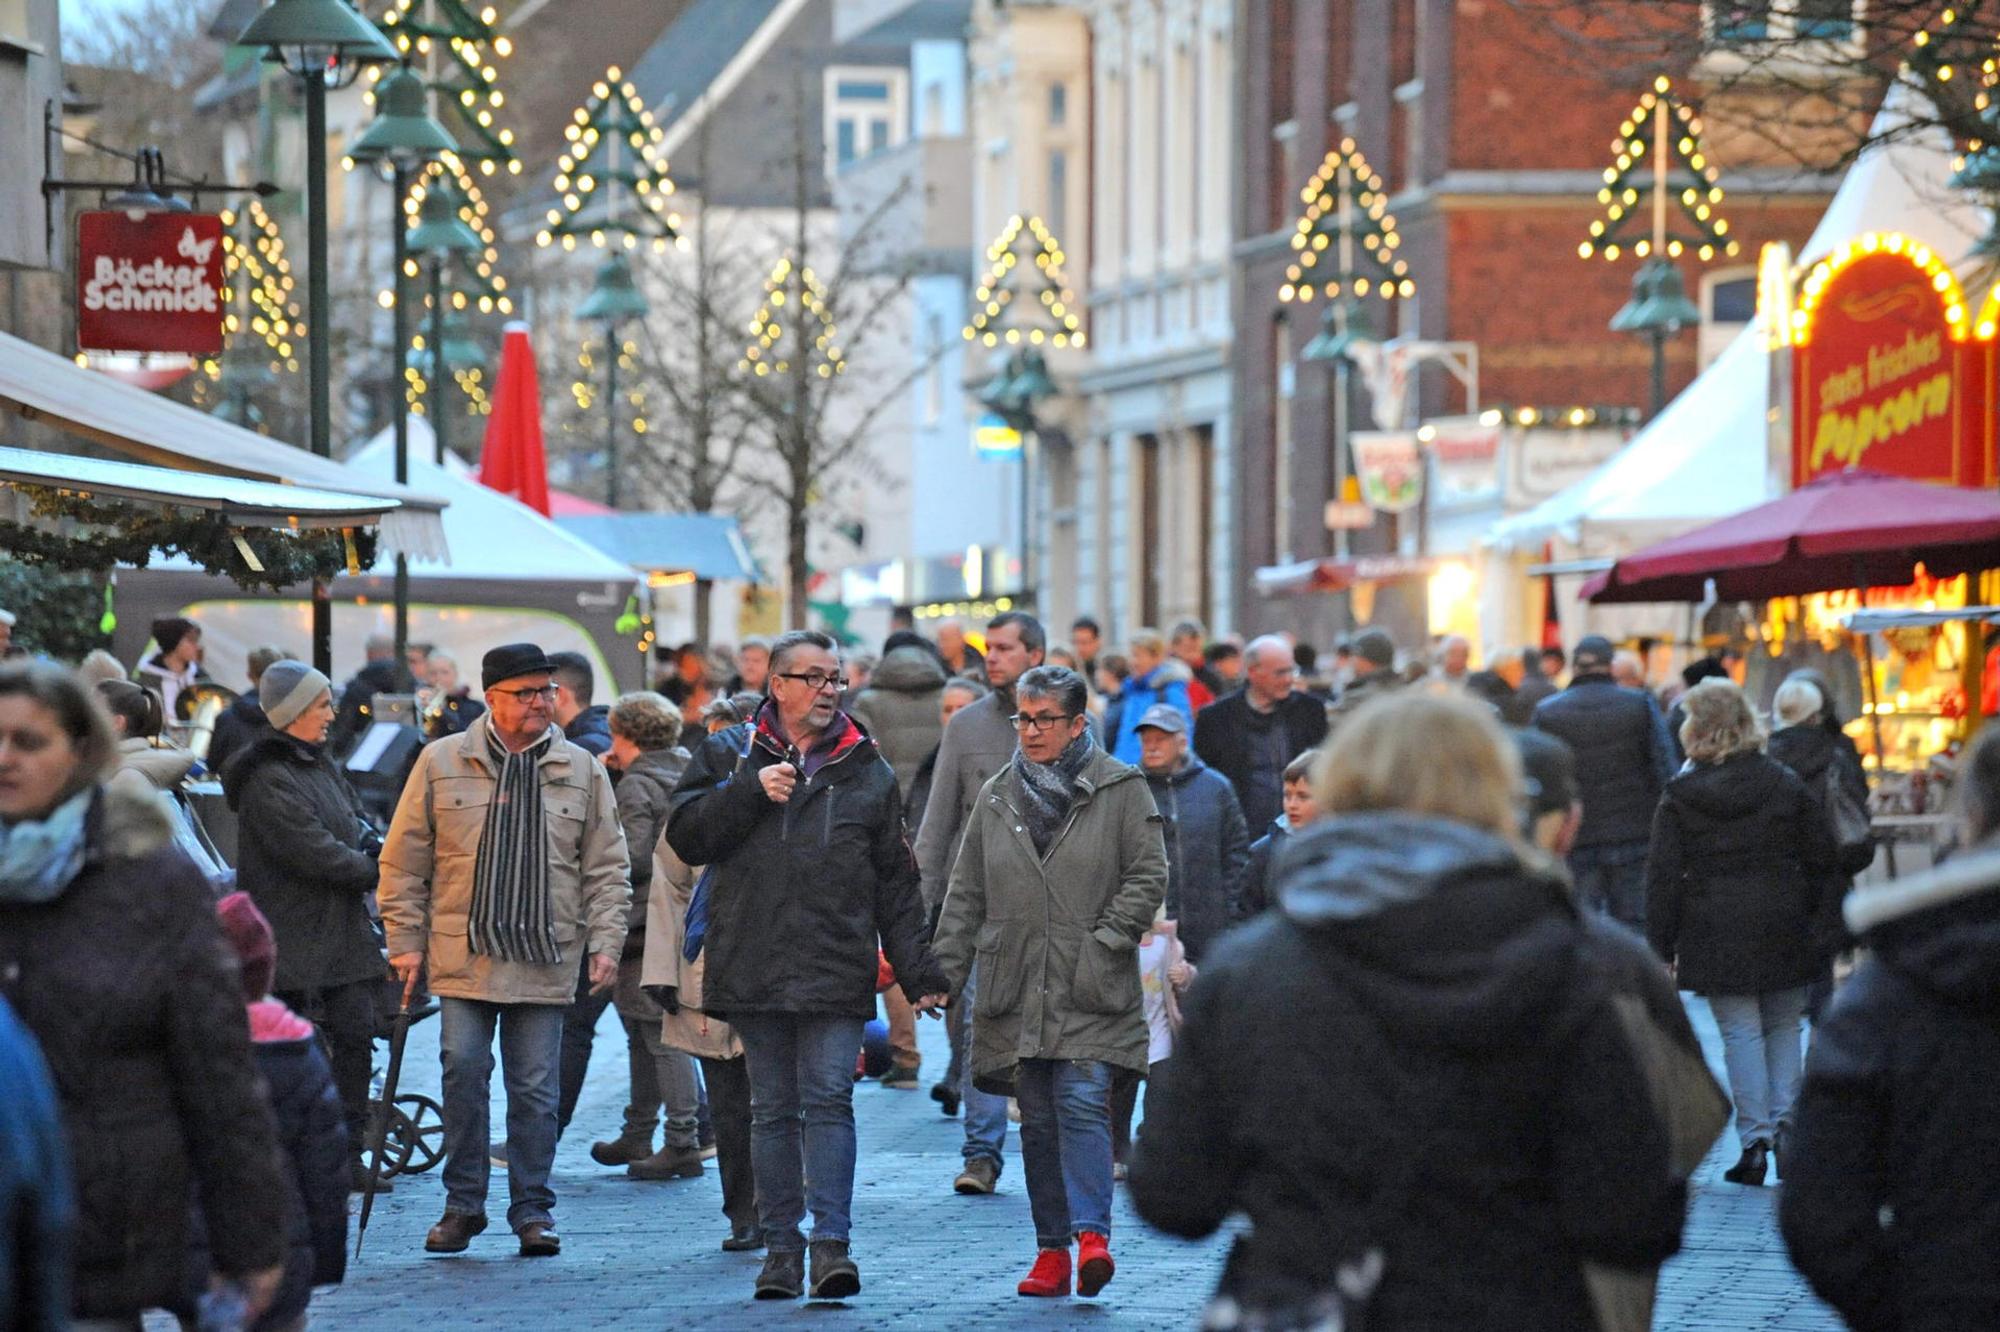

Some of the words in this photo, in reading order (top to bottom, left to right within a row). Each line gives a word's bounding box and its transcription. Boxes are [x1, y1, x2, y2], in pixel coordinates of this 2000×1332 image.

[94, 256, 207, 288] Bäcker
[84, 280, 217, 313] Schmidt
[1809, 372, 1951, 473] Popcorn
